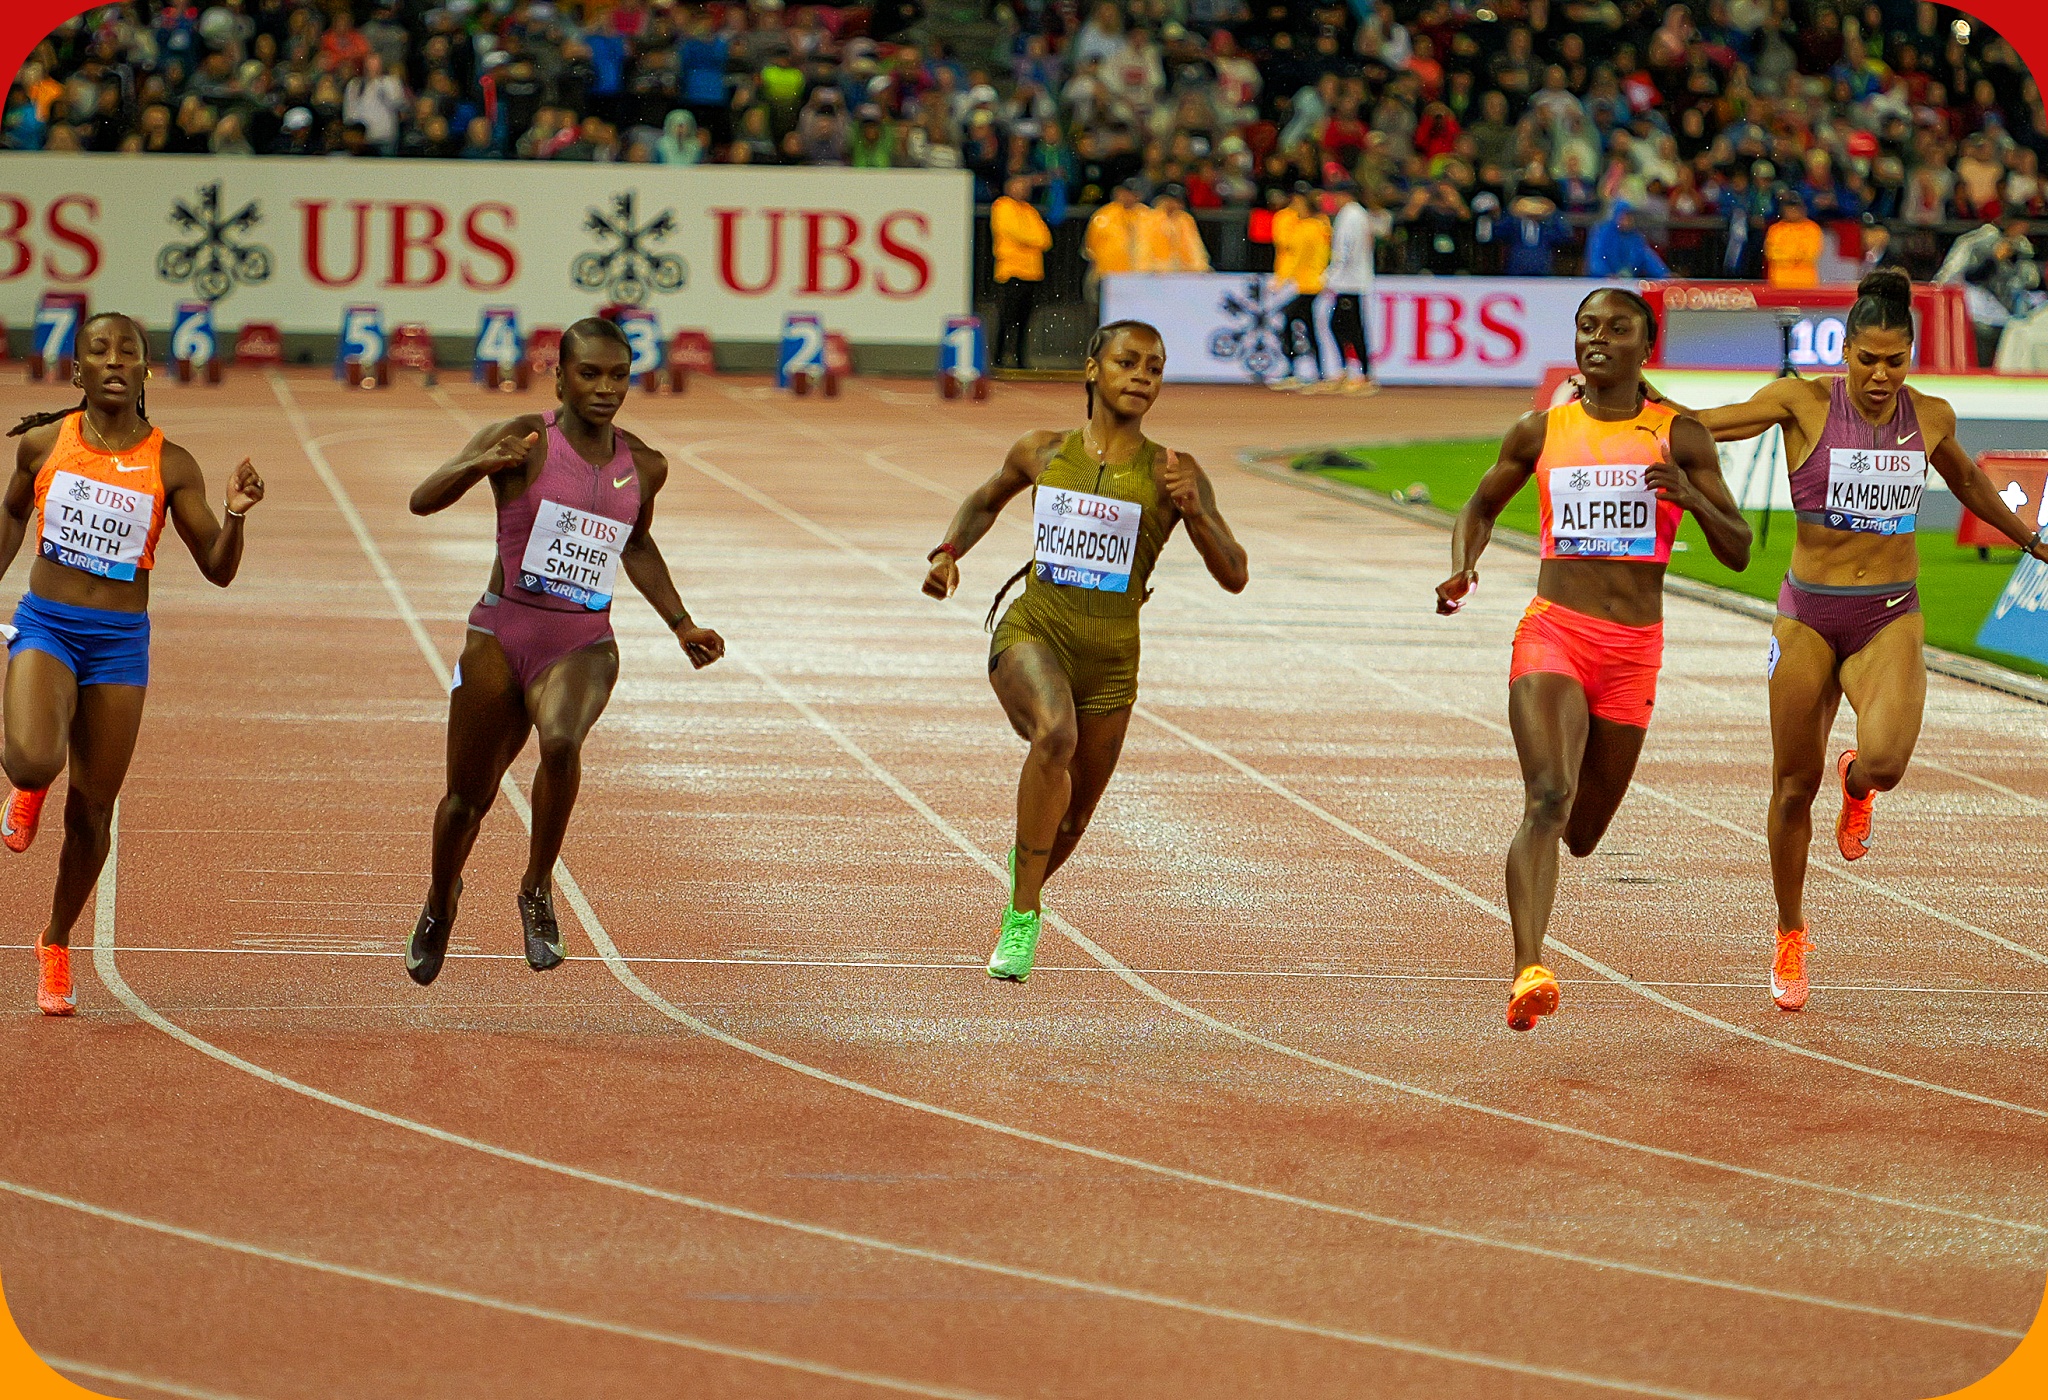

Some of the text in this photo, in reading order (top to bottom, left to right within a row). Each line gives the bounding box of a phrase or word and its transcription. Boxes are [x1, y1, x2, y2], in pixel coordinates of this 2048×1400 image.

[295, 200, 521, 290] UBS
[710, 207, 933, 298] UBS
[36, 308, 77, 365] 7
[172, 312, 214, 368] 6
[344, 313, 384, 365] 5
[475, 316, 522, 369] 4
[622, 319, 662, 376] 3
[782, 323, 825, 380] 2
[944, 326, 981, 384] 1
[1595, 470, 1638, 487] UBS
[1874, 455, 1911, 472] UBS
[95, 487, 137, 513] UBS
[1077, 498, 1120, 522] UBS
[61, 505, 132, 538] TA LOU
[580, 517, 618, 543] UBS
[1561, 501, 1648, 531] ALFRED
[1851, 518, 1898, 532] ZURICH
[60, 526, 121, 556] SMITH
[548, 538, 608, 568] ASHER
[1036, 523, 1131, 565] RICHARDSON
[1578, 539, 1629, 552] ZURICH
[57, 549, 110, 574] ZURICH
[544, 558, 601, 586] SMITH
[1052, 567, 1101, 585] ZURICH
[543, 581, 591, 603] ZURICH
